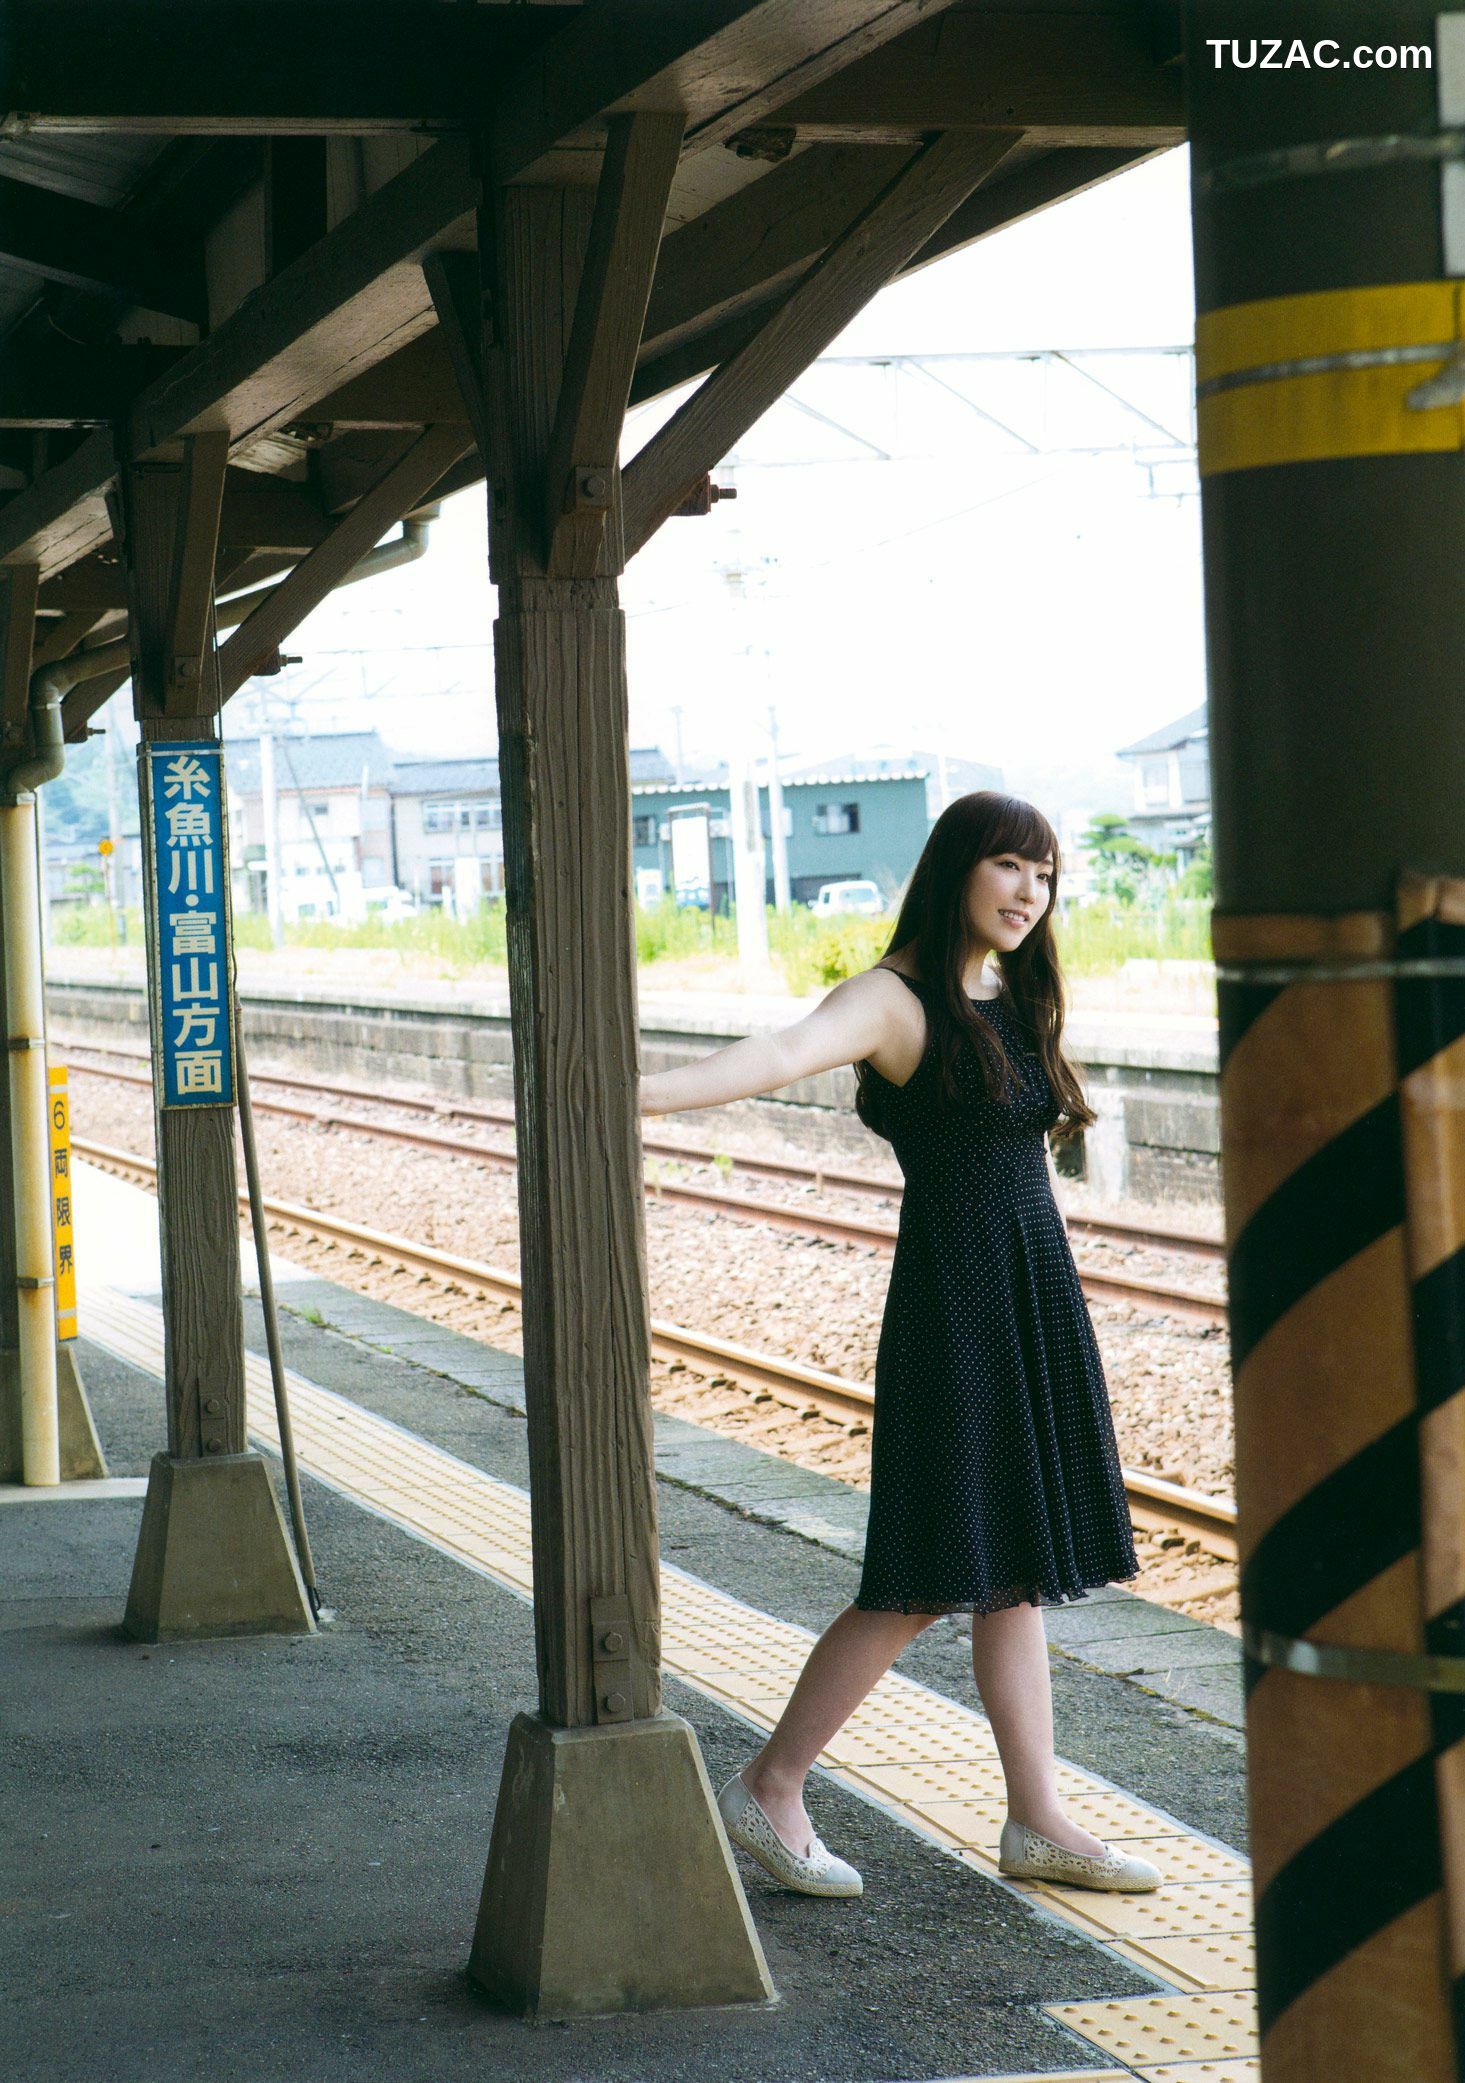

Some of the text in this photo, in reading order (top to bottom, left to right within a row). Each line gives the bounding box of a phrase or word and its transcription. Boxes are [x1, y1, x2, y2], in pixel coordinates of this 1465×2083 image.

[163, 755, 222, 1096] 糸魚川・富山方面
[53, 1100, 73, 1275] 6両限界
